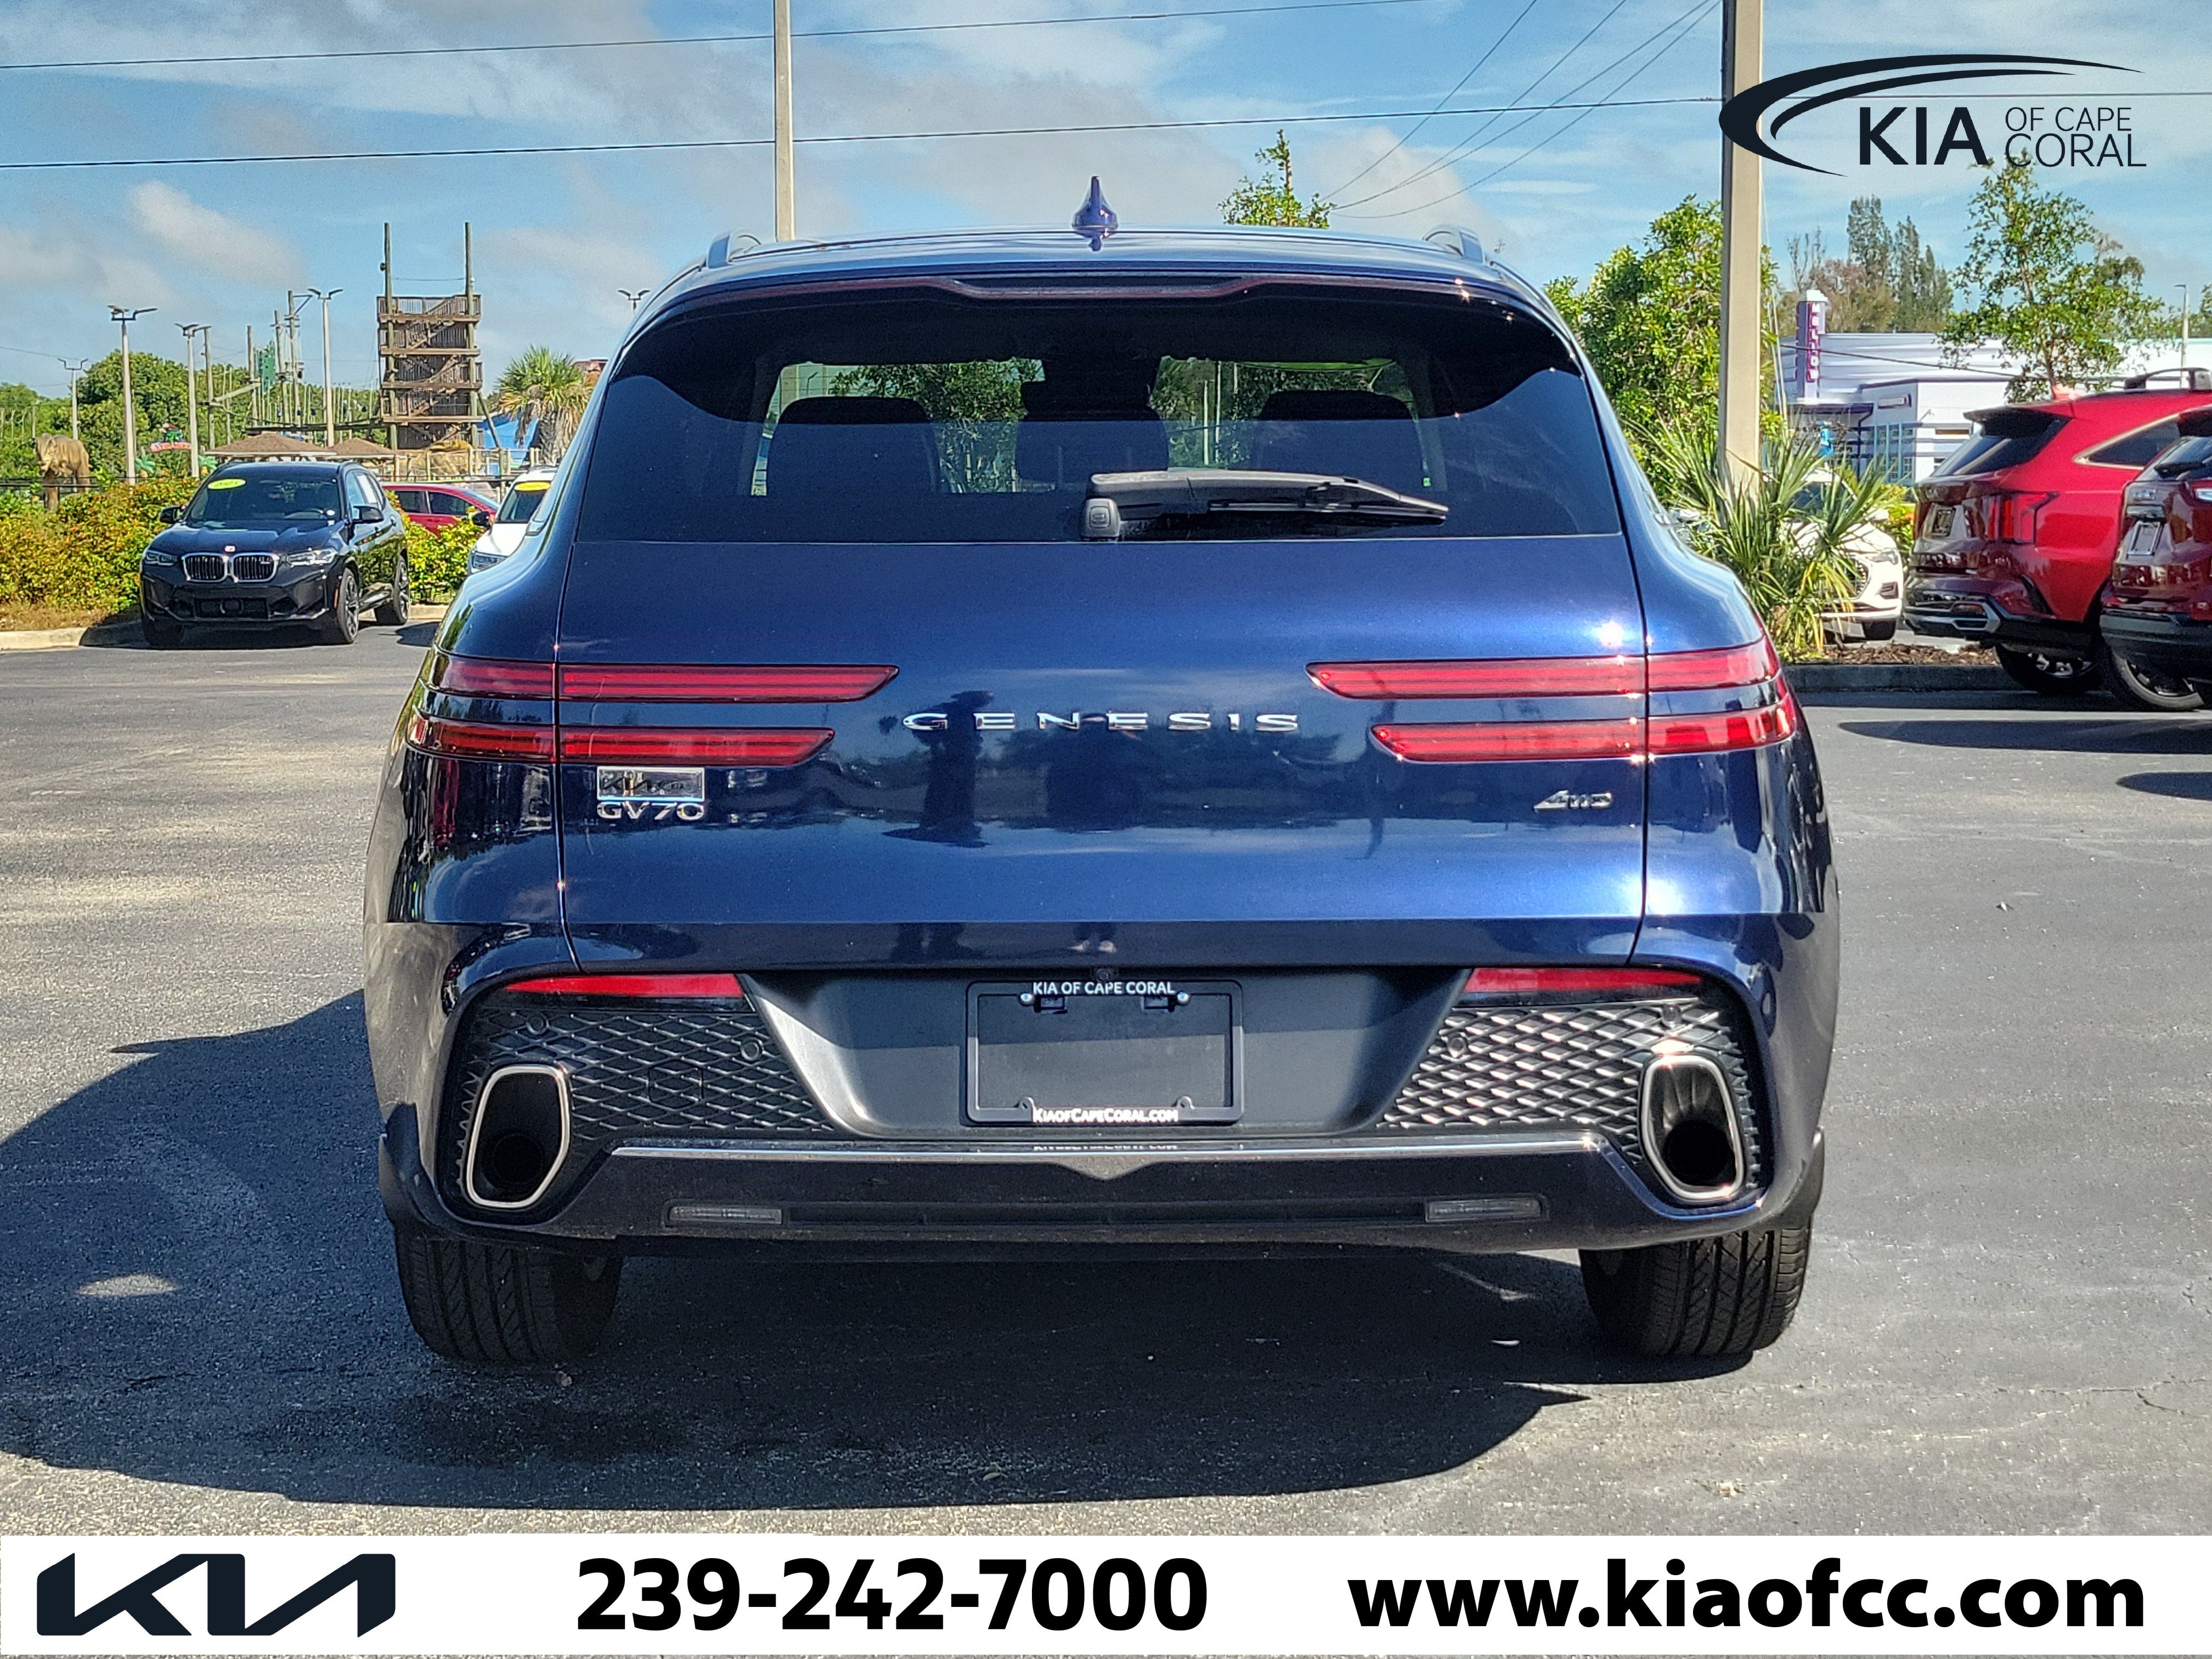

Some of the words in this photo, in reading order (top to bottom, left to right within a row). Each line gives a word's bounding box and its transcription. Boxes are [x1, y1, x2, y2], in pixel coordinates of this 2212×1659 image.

[903, 712, 1299, 731] GENESIS
[597, 800, 704, 821] GV70
[1032, 981, 1058, 995] KIA
[1061, 981, 1081, 995] OF
[1084, 981, 1122, 995] CAPE
[1126, 981, 1176, 995] CORAL
